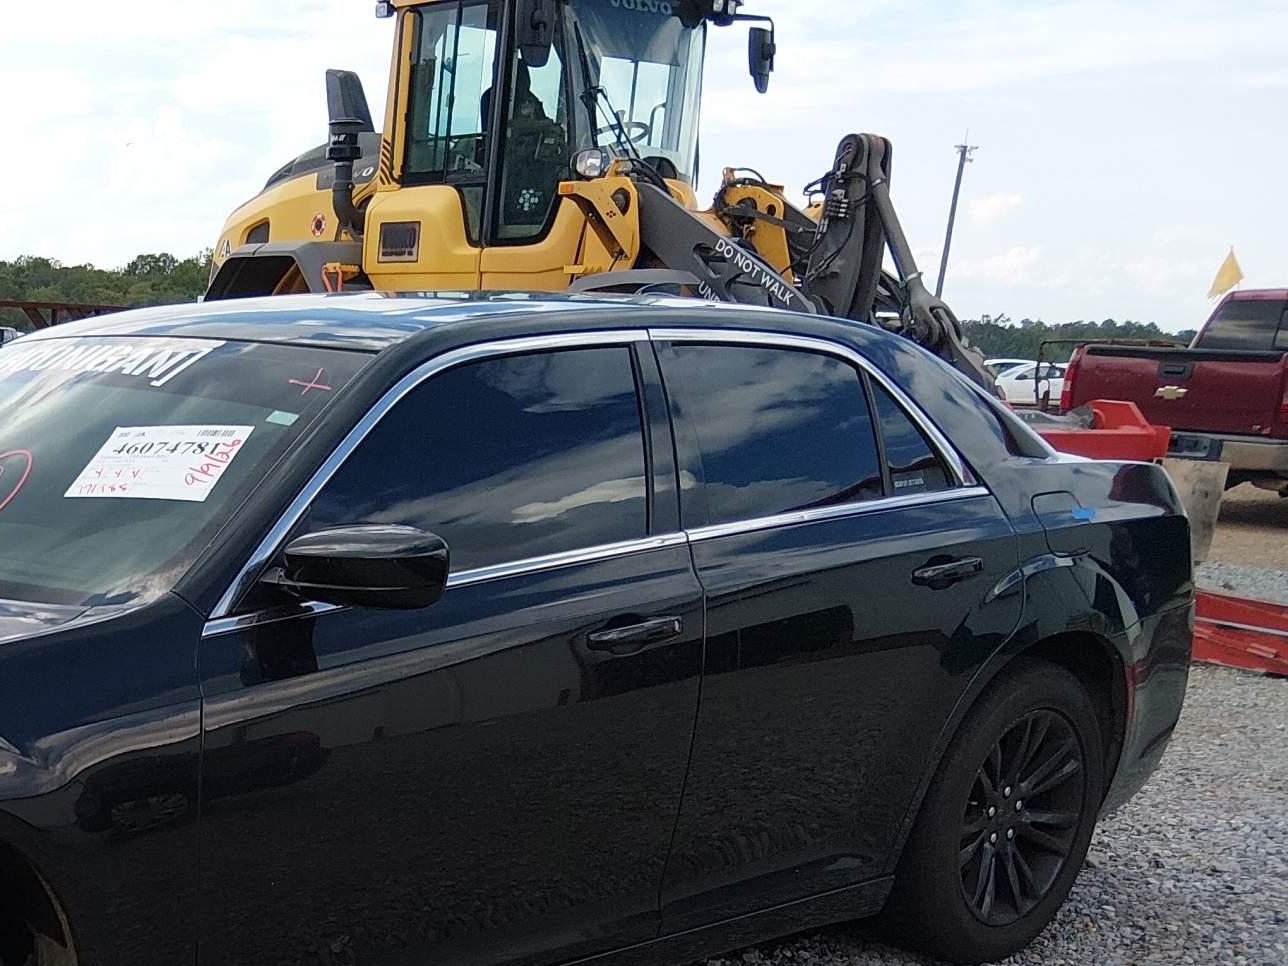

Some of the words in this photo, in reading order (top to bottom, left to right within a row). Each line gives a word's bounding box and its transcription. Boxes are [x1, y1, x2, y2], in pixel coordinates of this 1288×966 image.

[610, 0, 672, 15] VOLVO
[715, 239, 734, 258] DO
[734, 253, 762, 278] NOT
[760, 272, 794, 306] WALK
[113, 441, 221, 455] 46074781
